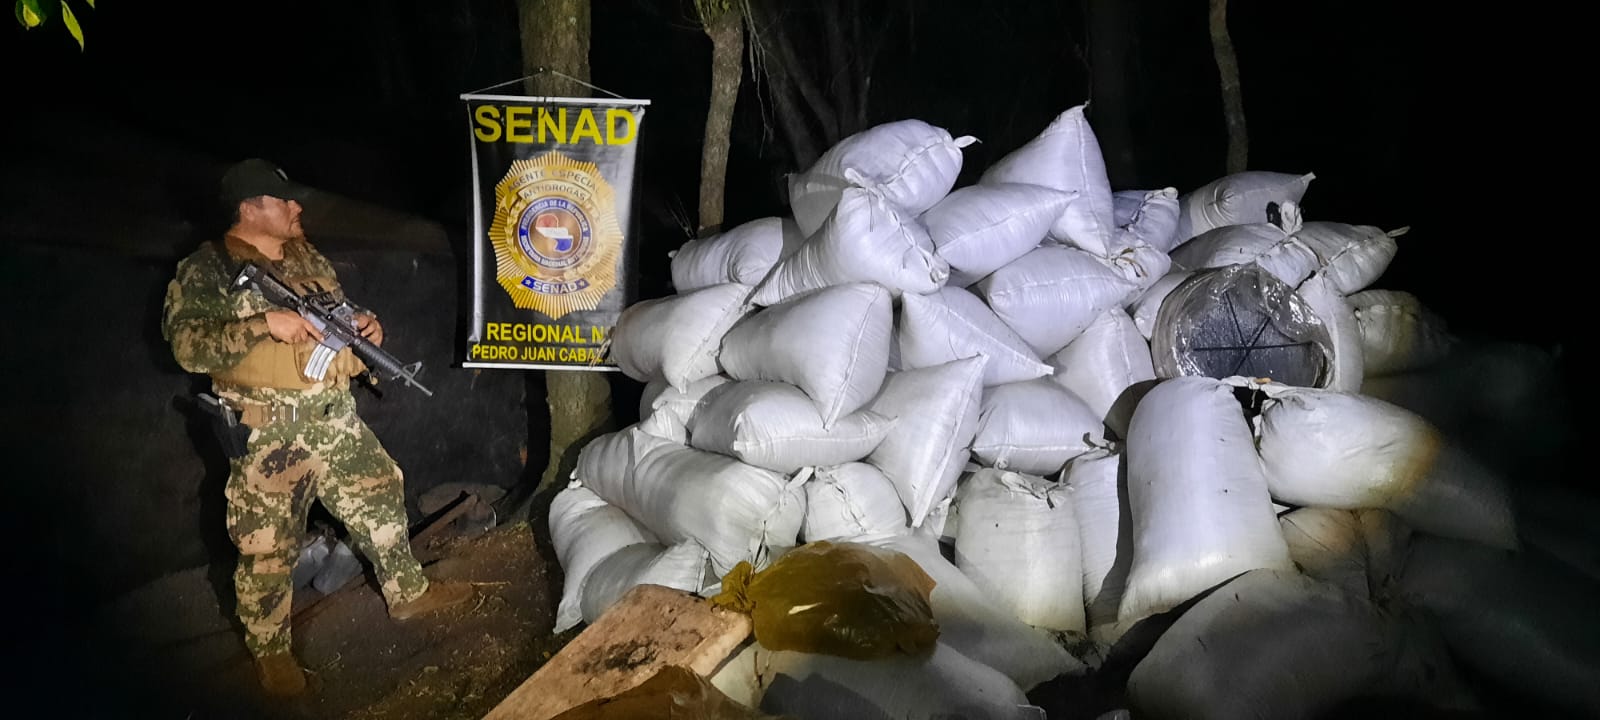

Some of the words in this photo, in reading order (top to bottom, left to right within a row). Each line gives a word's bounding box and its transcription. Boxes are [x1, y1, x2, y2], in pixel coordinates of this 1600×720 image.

[475, 105, 637, 145] SENAD
[533, 281, 577, 294] SENAD
[487, 323, 586, 343] REGIONAL
[472, 345, 518, 360] PEDRO
[521, 347, 556, 361] JUAN
